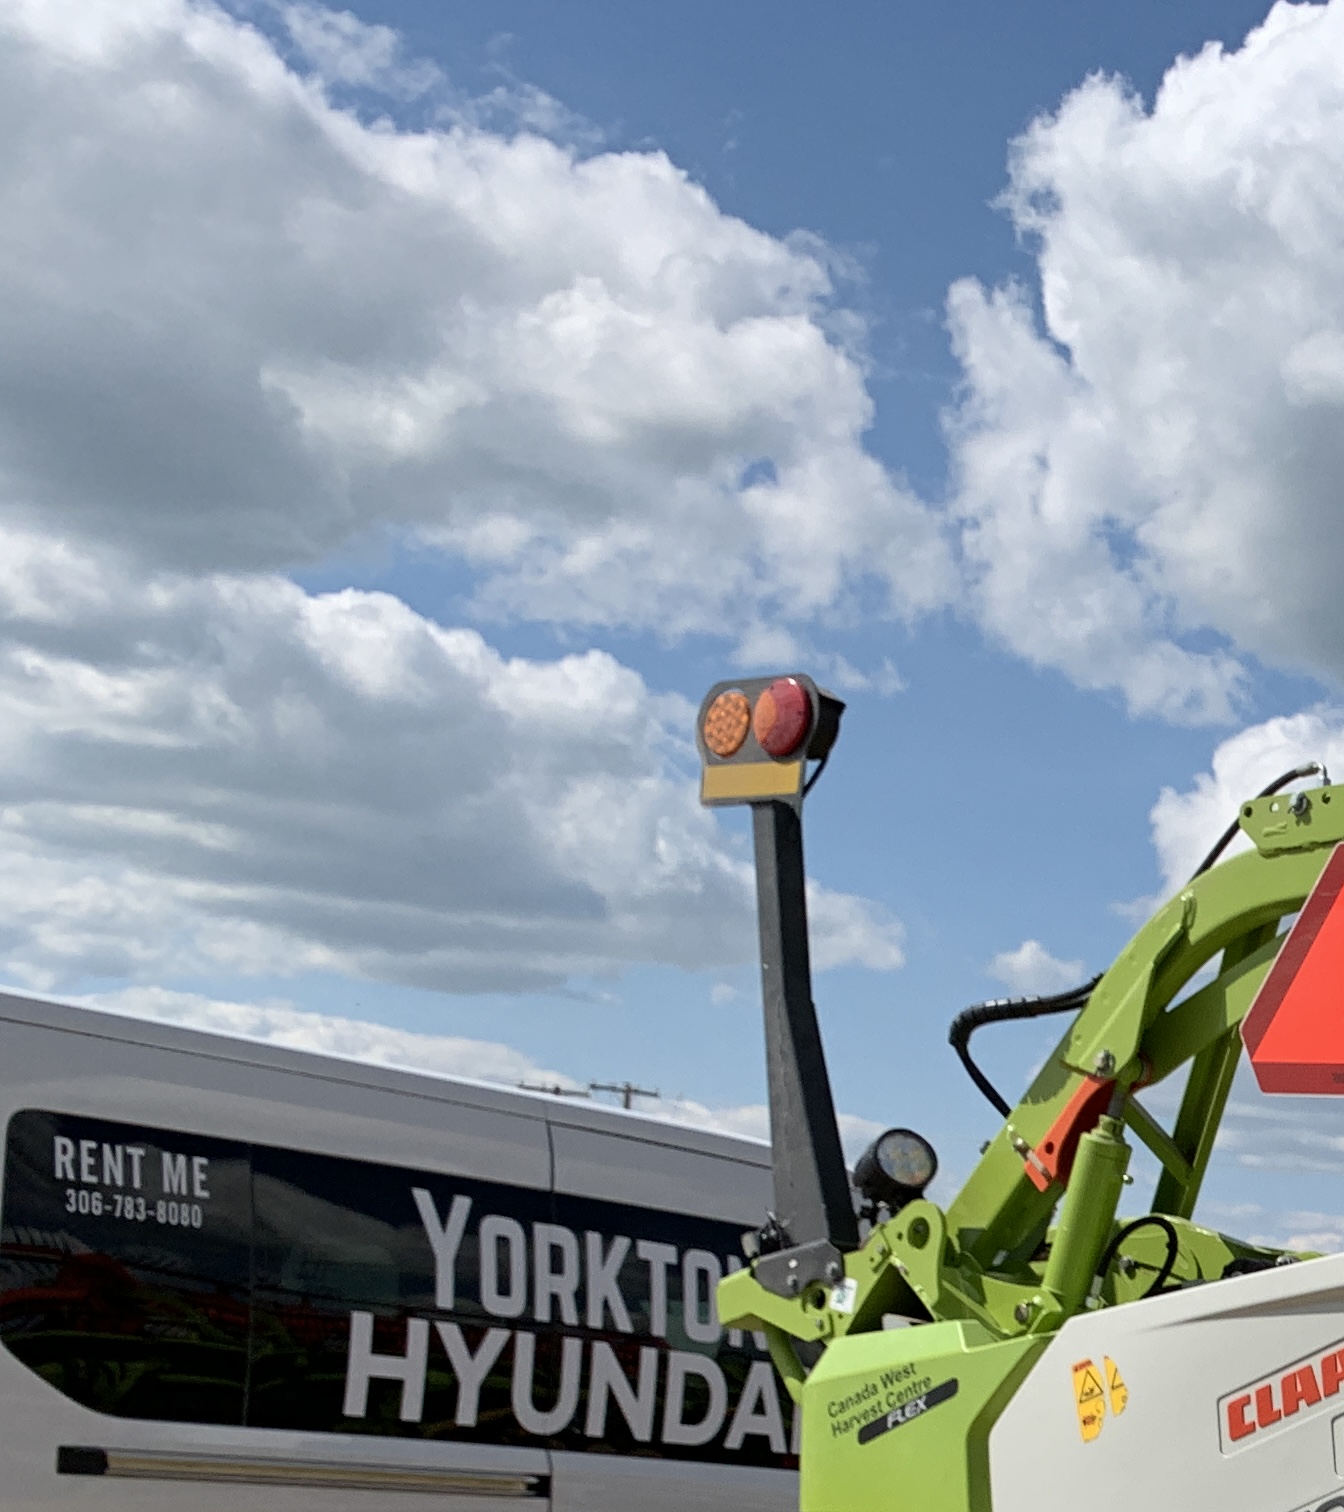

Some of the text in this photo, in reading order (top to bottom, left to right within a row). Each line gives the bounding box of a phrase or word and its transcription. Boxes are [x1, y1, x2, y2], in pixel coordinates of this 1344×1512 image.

[53, 1136, 210, 1198] RENT ME
[65, 1188, 203, 1228] 306-783-8080
[342, 1311, 801, 1456] HYUNDA
[827, 1362, 917, 1418] Canada West
[830, 1376, 932, 1438] Harvest Centre
[886, 1395, 927, 1429] FLEX
